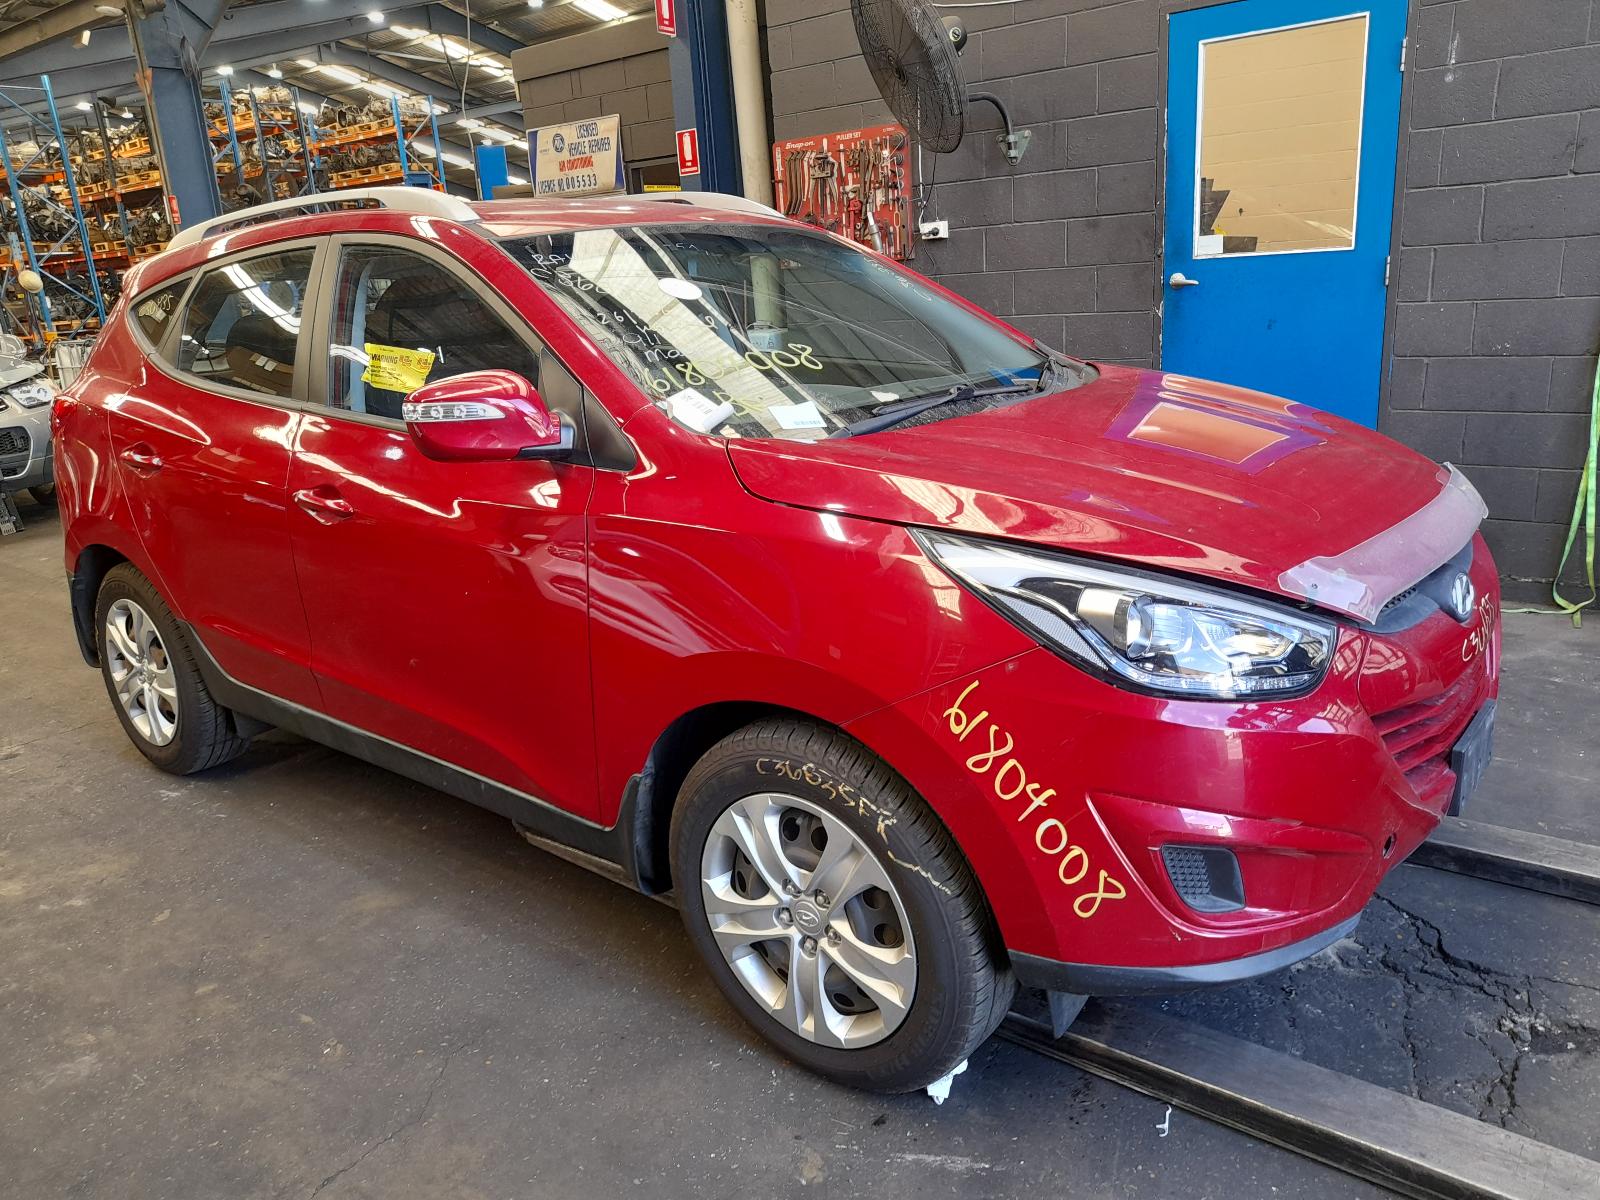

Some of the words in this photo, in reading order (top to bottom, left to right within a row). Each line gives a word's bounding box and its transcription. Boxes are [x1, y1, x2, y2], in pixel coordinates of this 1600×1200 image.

[576, 122, 599, 139] LICENSED
[836, 132, 852, 140] PULLER
[568, 141, 587, 157] VEHICLE
[588, 137, 612, 153] REPAIRER
[371, 353, 398, 365] WARNING
[943, 680, 1127, 919] 61804008
